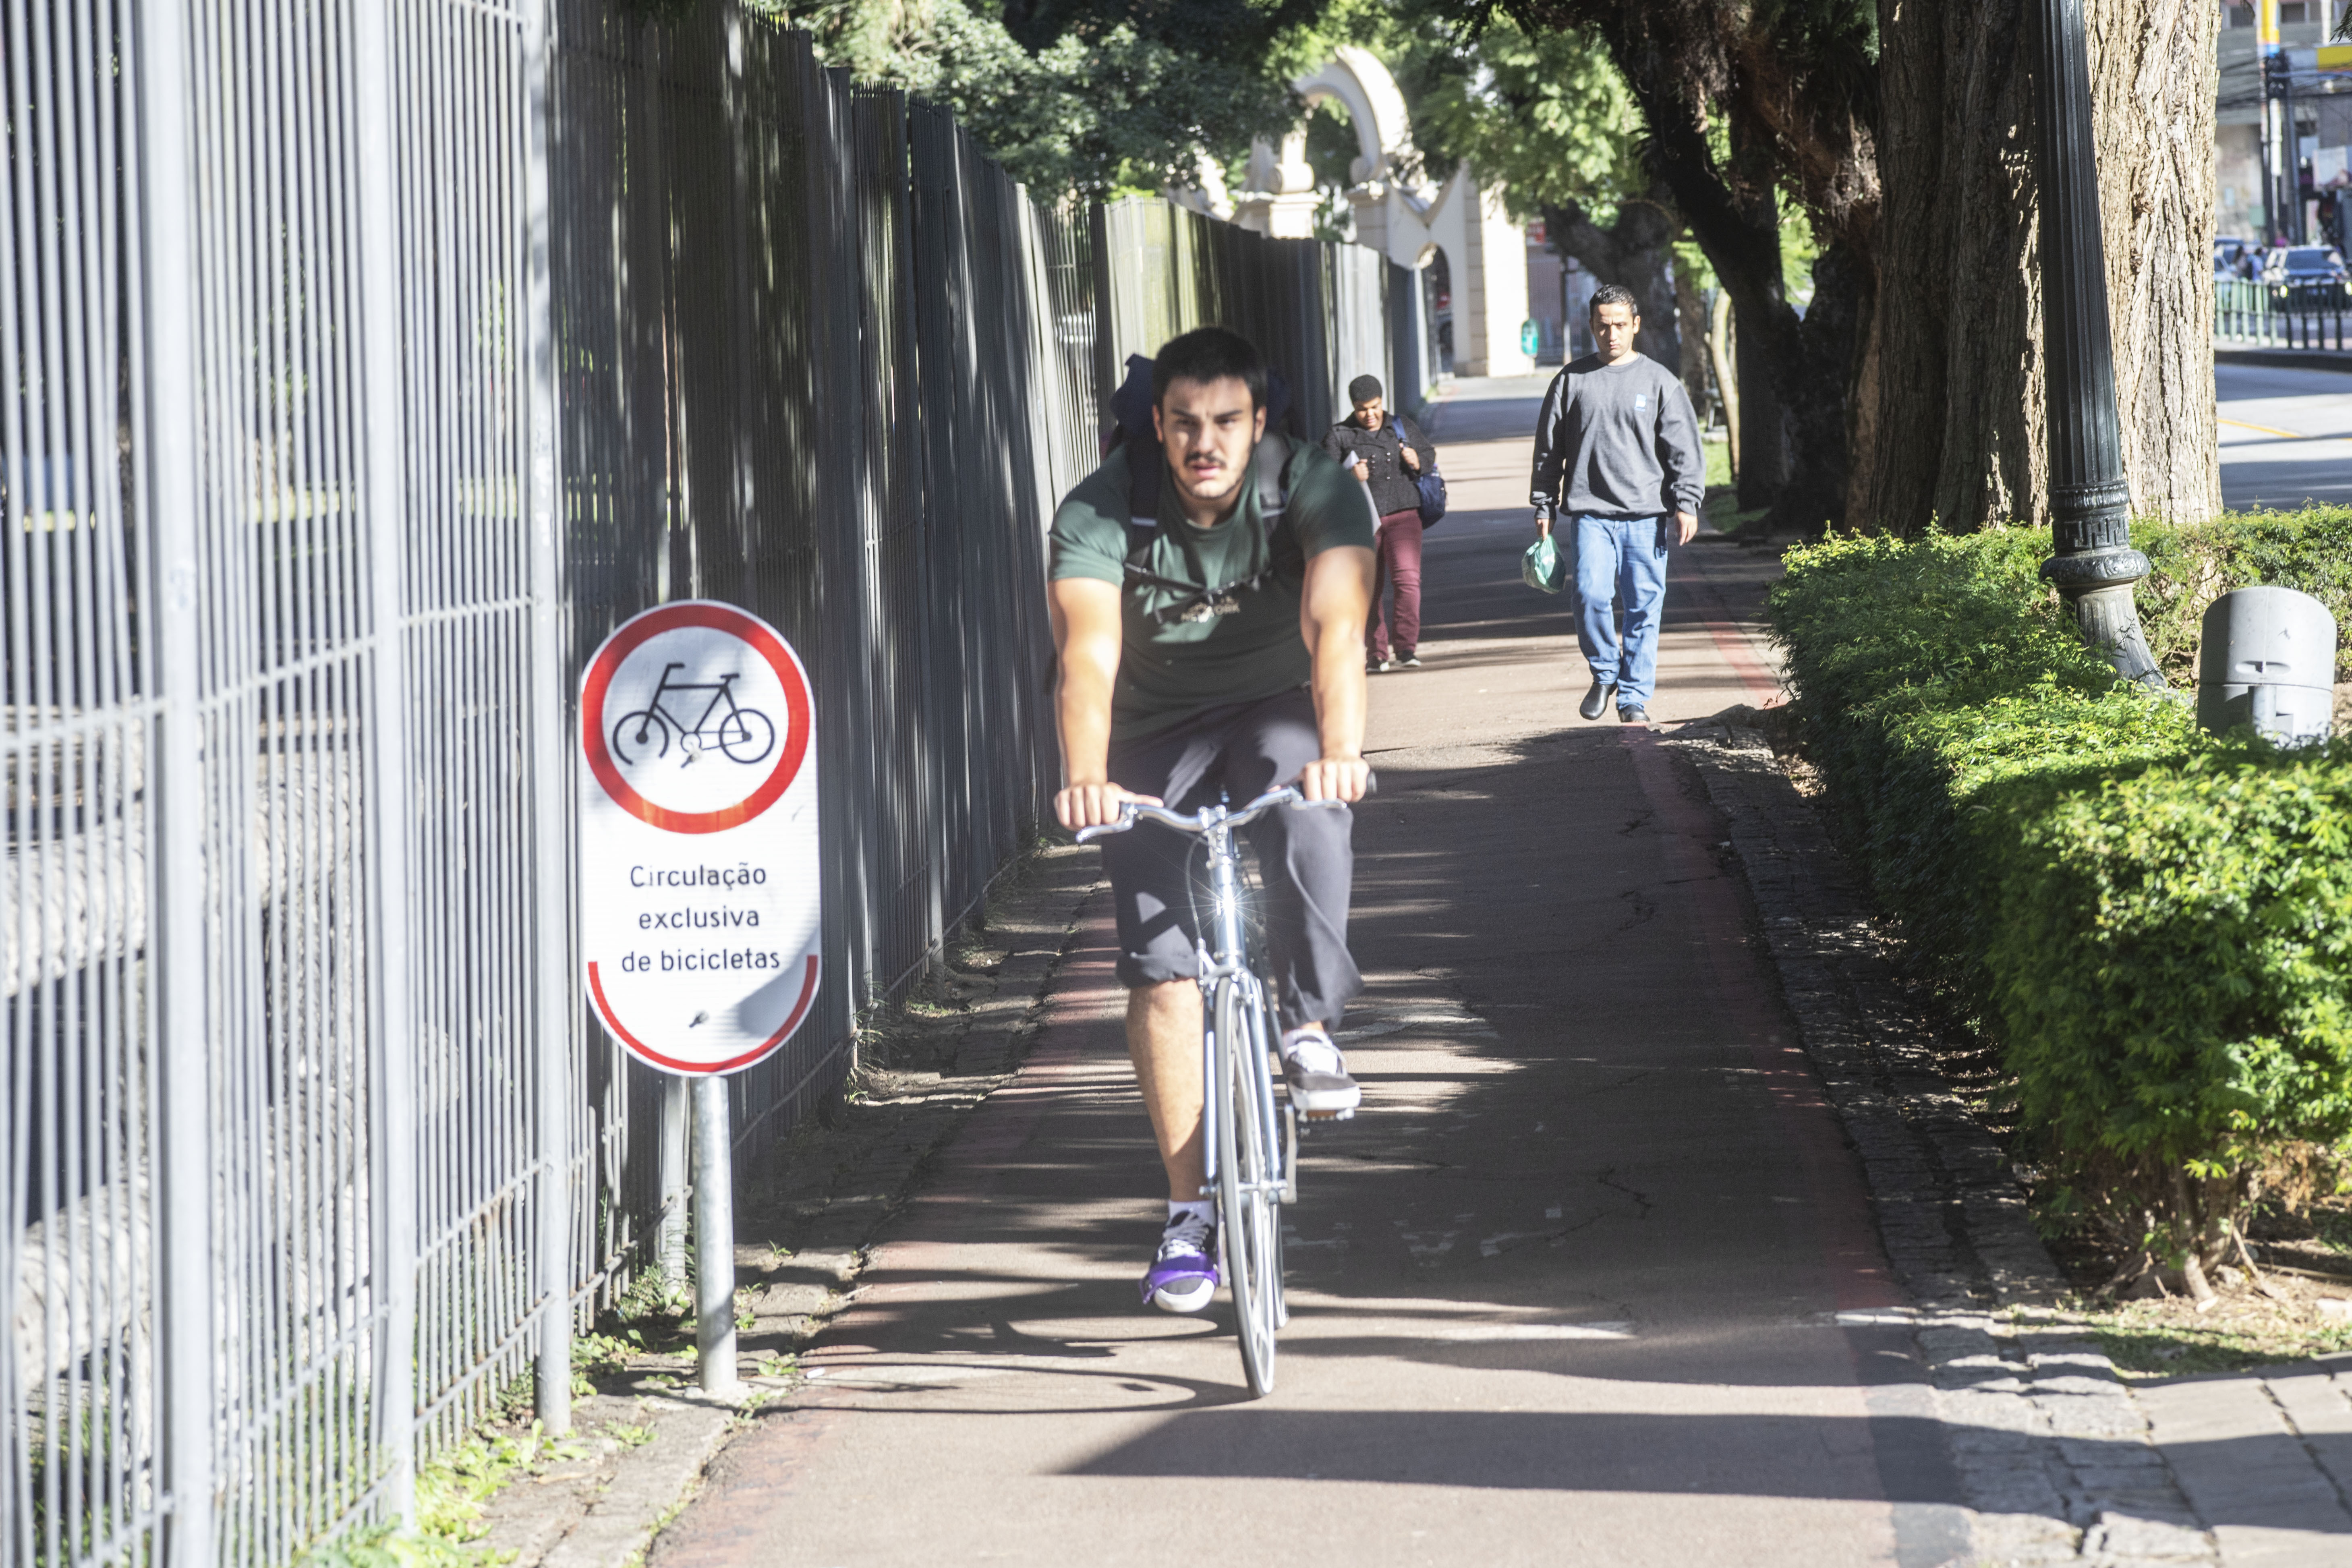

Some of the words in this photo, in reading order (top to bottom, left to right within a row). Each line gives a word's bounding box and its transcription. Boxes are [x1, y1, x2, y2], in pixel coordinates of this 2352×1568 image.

[630, 862, 766, 890] Circulação
[639, 906, 760, 930] exclusiva
[622, 951, 651, 972] de
[661, 948, 780, 971] bicicletas
